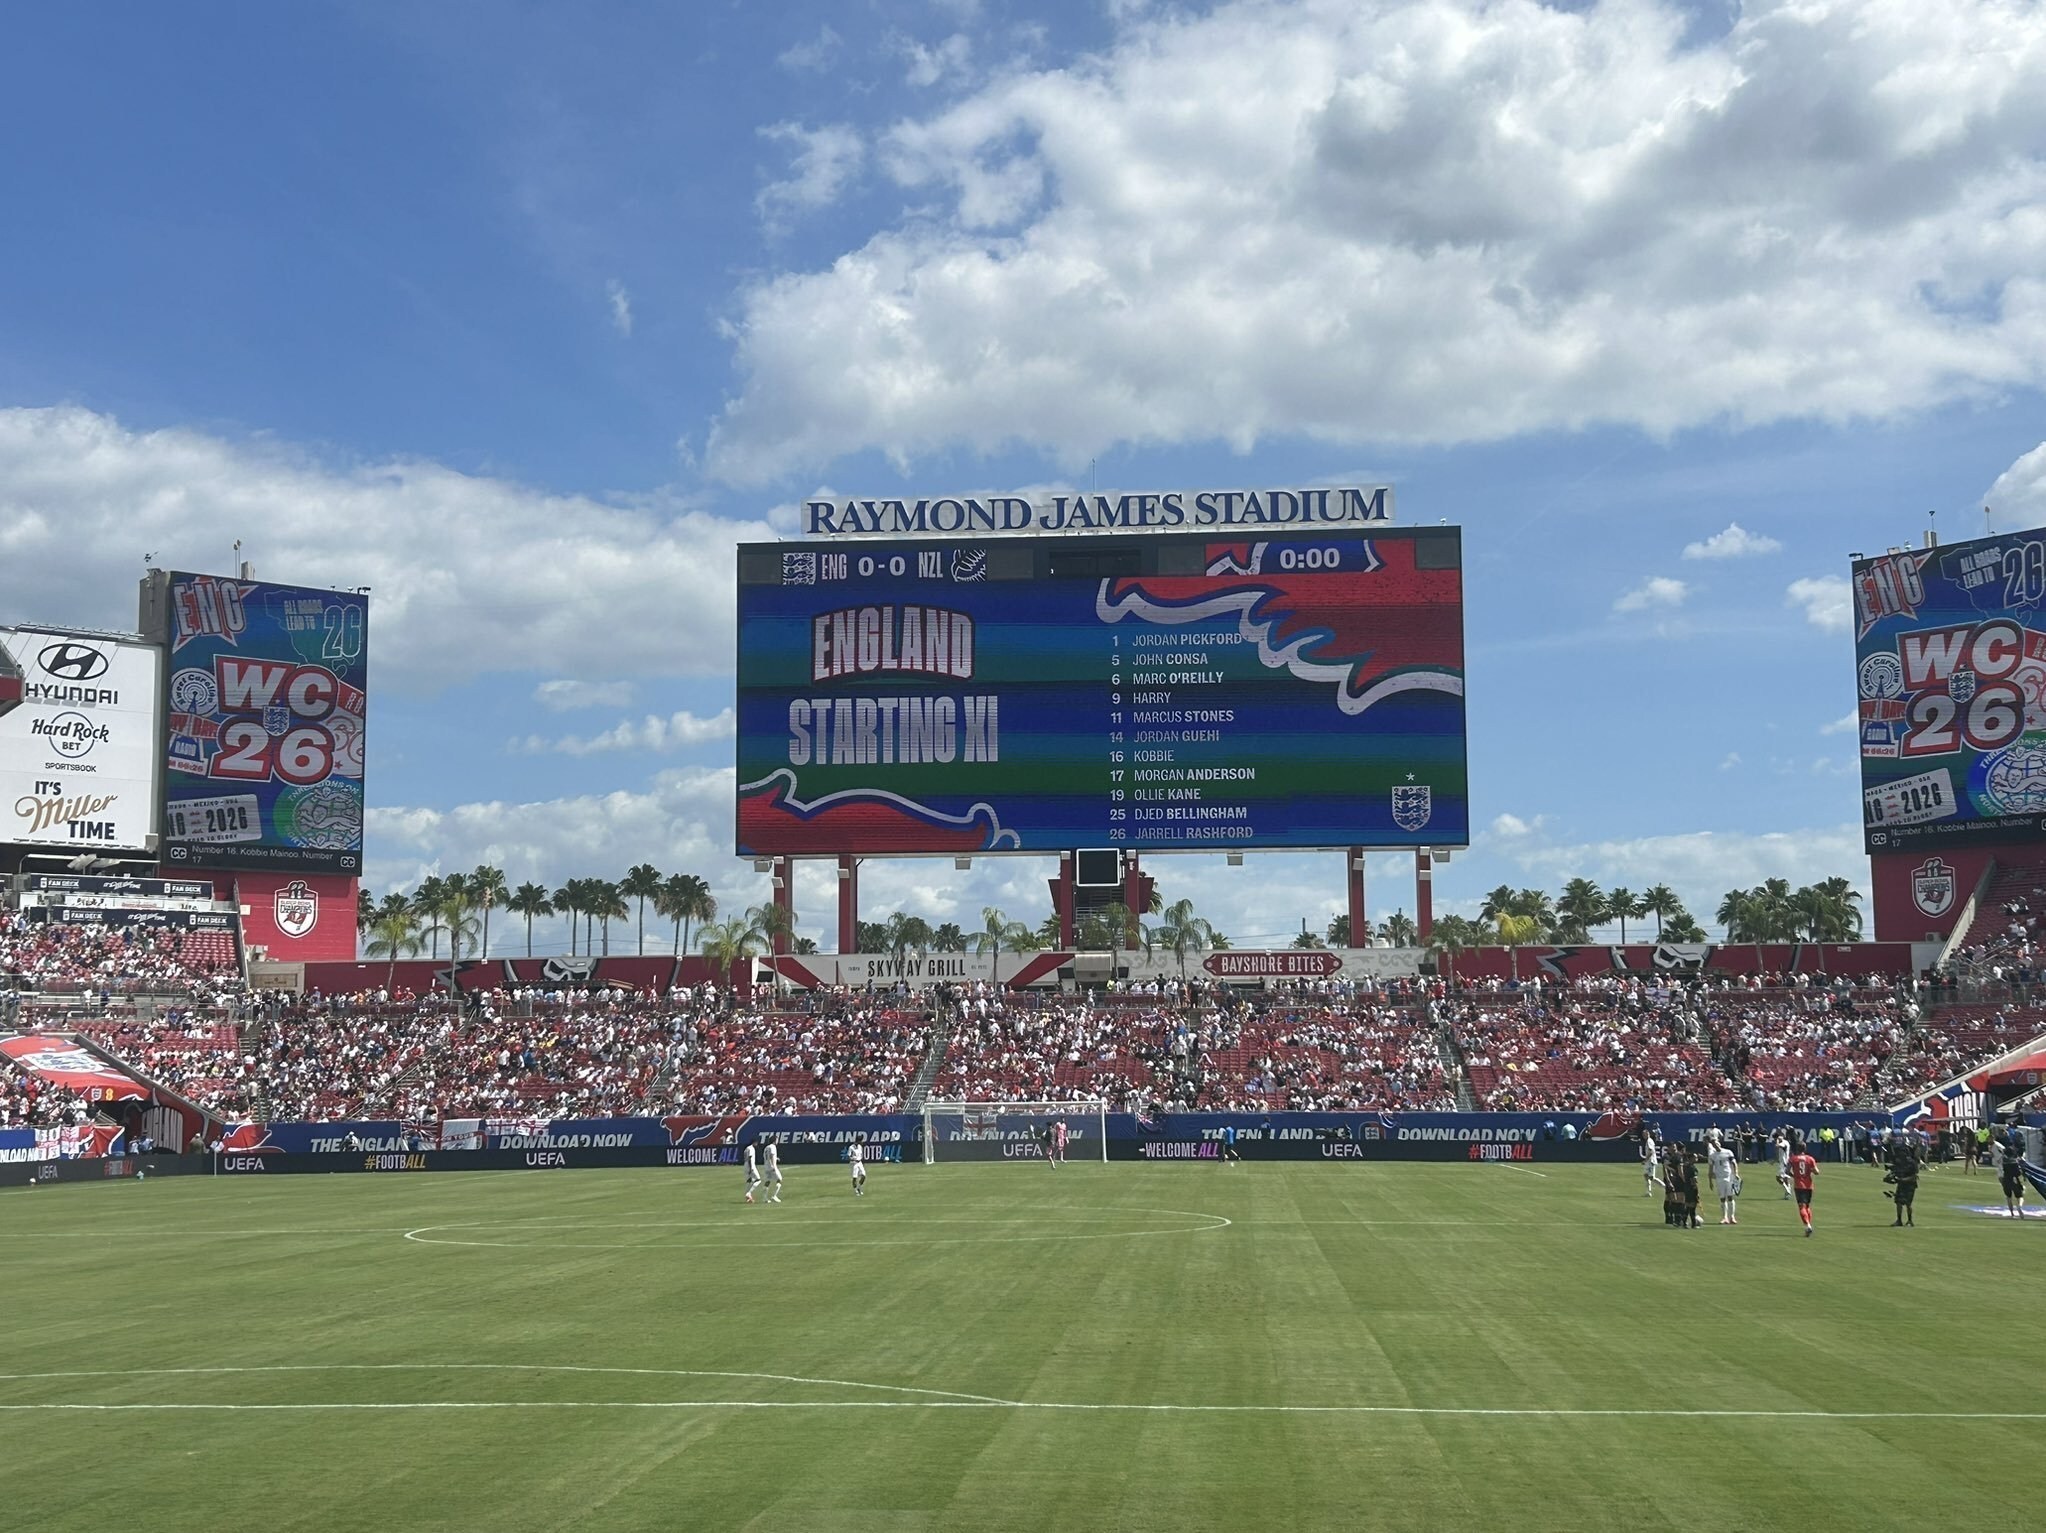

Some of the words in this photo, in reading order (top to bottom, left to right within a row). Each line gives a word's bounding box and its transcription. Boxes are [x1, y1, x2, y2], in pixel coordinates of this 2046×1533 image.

[807, 498, 1032, 533] RAYMOND
[1040, 494, 1184, 530] JAMES
[1195, 488, 1388, 525] STADIUM
[822, 553, 847, 580] ENG
[918, 551, 943, 578] NZL
[1280, 548, 1340, 569] 0:00
[2002, 541, 2045, 608] 26
[1855, 556, 1923, 623] ENG
[173, 581, 245, 636] ENG
[322, 604, 361, 658] 26
[814, 605, 972, 681] ENGLAND
[1113, 636, 1118, 646] 1
[1133, 634, 1177, 646] JORDAN
[1181, 633, 1242, 645] PICKFORD
[1112, 655, 1119, 666] 5
[1133, 654, 1163, 666] JOHN
[1166, 653, 1208, 665] CONSA
[1905, 626, 2017, 683] WC
[1112, 674, 1120, 685] 6
[1133, 673, 1166, 684] MARC
[1169, 672, 1224, 684] O'REILLY
[25, 683, 118, 704] HYUNDAI
[222, 662, 334, 717] WC
[1112, 693, 1120, 704] 9
[1133, 692, 1171, 704] HARRY
[1111, 712, 1121, 723] 11
[1133, 711, 1182, 723] MARCUS
[1184, 710, 1234, 722] STONES
[1910, 688, 2016, 748] 26
[32, 717, 71, 737] Hard
[73, 720, 109, 742] Rock
[789, 696, 956, 766] STARTING
[963, 695, 998, 762] XI
[1109, 731, 1123, 742] 14
[1134, 730, 1178, 743] JORDAN
[1182, 730, 1219, 742] GUEHI
[62, 742, 81, 751] BET
[219, 722, 329, 778] 26
[1109, 751, 1123, 762] 16
[1134, 750, 1174, 762] KOBBIE
[45, 763, 97, 772] SPORTSBOOK
[1110, 770, 1124, 781] 17
[1134, 769, 1184, 781] MORGAN
[1186, 768, 1255, 780] ANDERSON
[1110, 789, 1124, 801] 19
[1134, 788, 1165, 800] OLLIE
[1168, 788, 1201, 800] KANE
[1901, 783, 1942, 814] 2026
[15, 794, 118, 834] Miller
[206, 806, 248, 833] 2026
[1110, 809, 1126, 820] 25
[1135, 808, 1163, 820] DJED
[1166, 807, 1247, 819] BELLINGHAM
[67, 820, 115, 840] TIME
[1110, 828, 1126, 840] 26
[1135, 827, 1183, 840] JARRELL
[1186, 826, 1253, 839] RASHFORD
[172, 849, 186, 858] CC
[192, 845, 224, 855] Number
[302, 851, 333, 860] Number
[341, 857, 355, 867] CC
[928, 959, 966, 976] GRILL
[1222, 956, 1283, 973] BAYSHORE
[1288, 955, 1324, 972] BITES
[593, 1134, 633, 1147] NOW
[1398, 1128, 1492, 1141] DOWNLOAD
[667, 1148, 717, 1164] WELCOME
[718, 1148, 739, 1162] ALL
[1003, 1144, 1043, 1157] UEFA
[1145, 1142, 1197, 1158] WELCOME
[1198, 1143, 1219, 1158] ALL
[1322, 1144, 1363, 1157] UEFA
[1468, 1144, 1532, 1159] #FOOTBALL
[225, 1158, 265, 1171] UEFA
[365, 1154, 426, 1169] #FOOTBALL
[526, 1152, 565, 1165] UEFA
[38, 1165, 58, 1179] UEFA
[1799, 1162, 1806, 1175] 9
